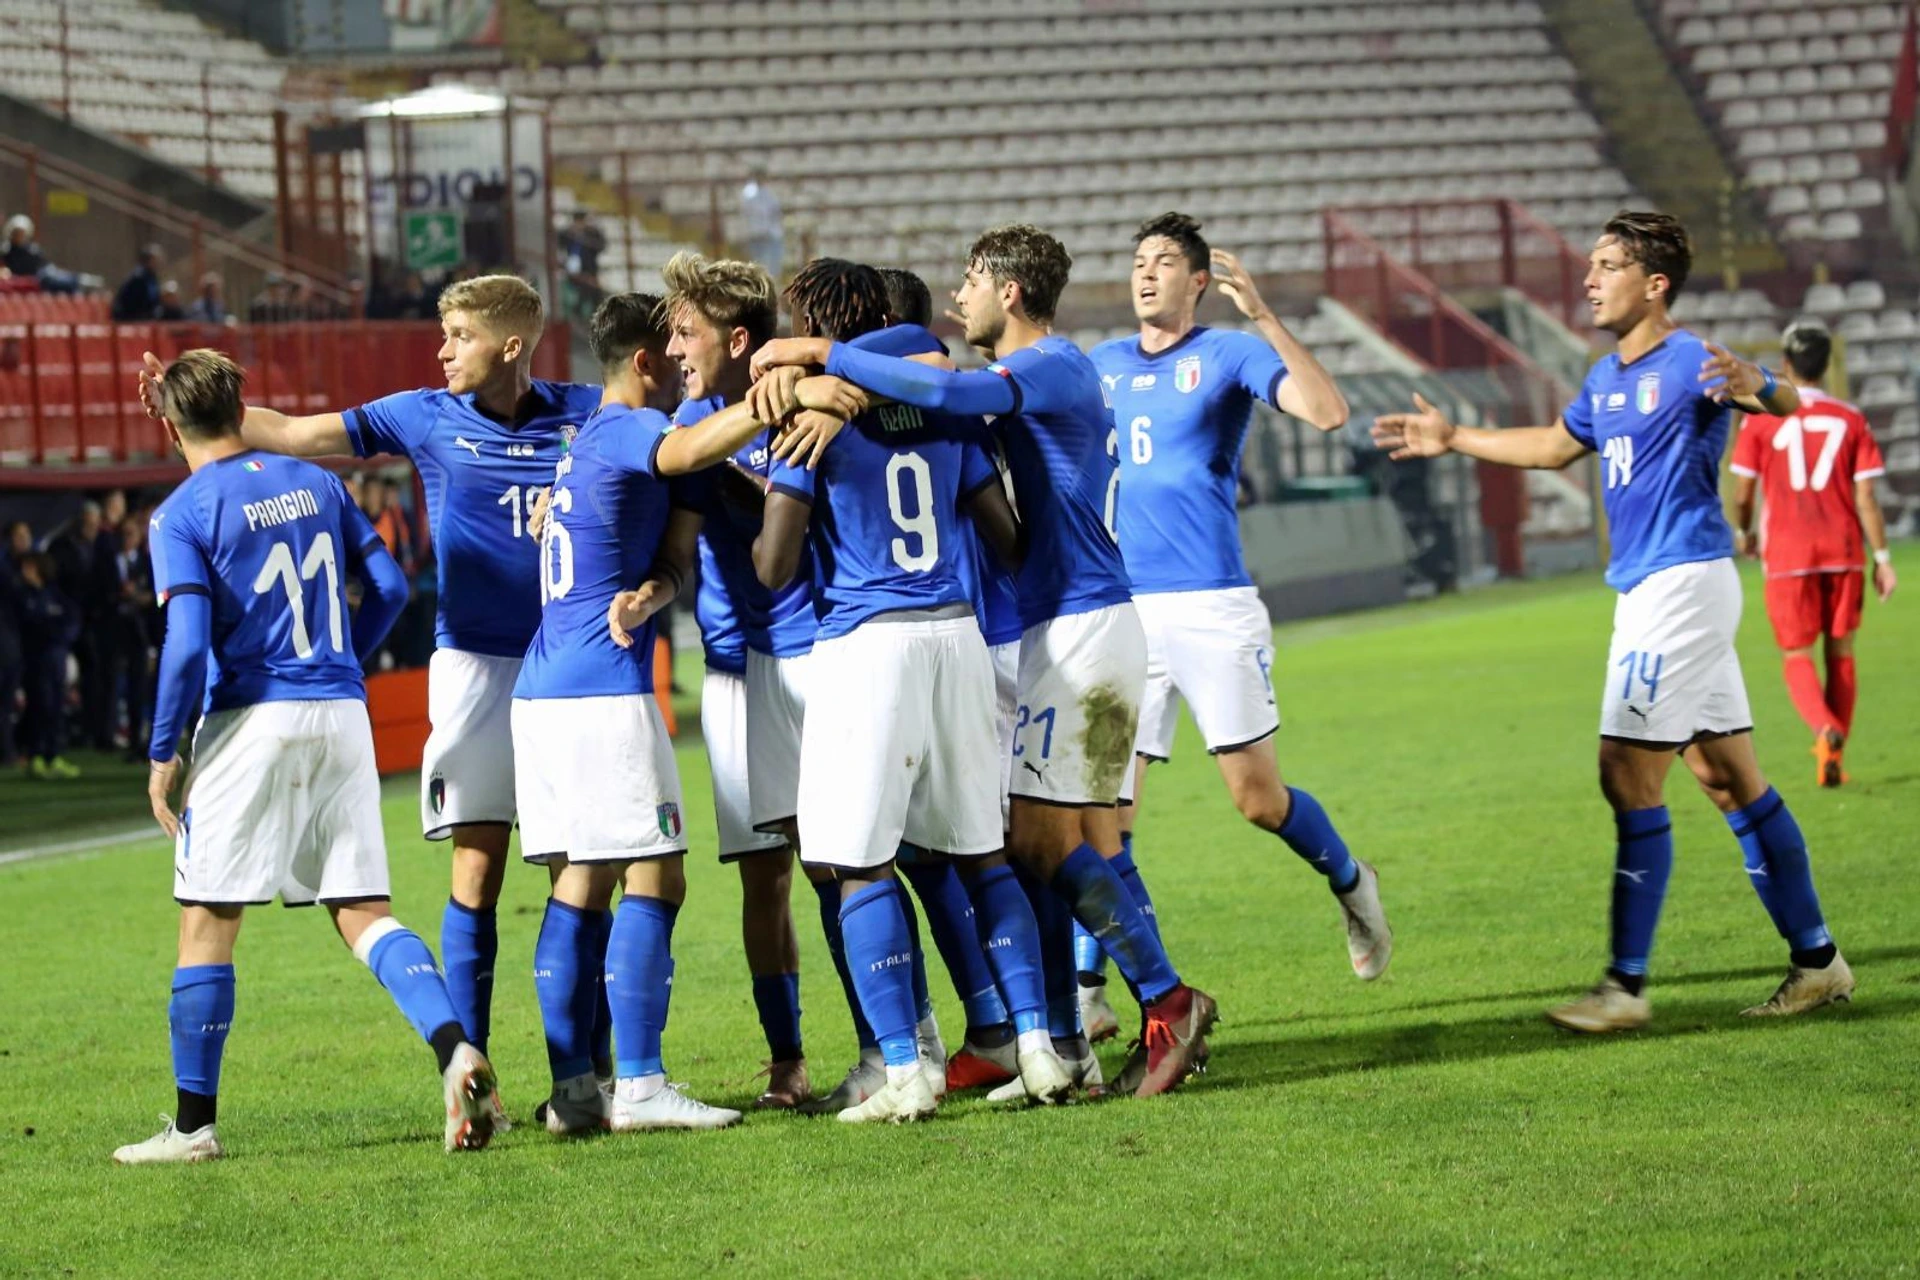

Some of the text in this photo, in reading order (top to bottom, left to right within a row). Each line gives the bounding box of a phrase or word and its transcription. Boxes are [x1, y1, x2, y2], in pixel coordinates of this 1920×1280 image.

[1130, 415, 1153, 465] 6
[1603, 435, 1634, 489] 14
[1772, 414, 1847, 492] 17
[243, 489, 319, 532] PARIGINI
[886, 451, 939, 573] 9
[253, 531, 344, 659] 11
[1618, 650, 1663, 703] 14
[1013, 704, 1056, 759] 21
[871, 952, 911, 973] ITALIA
